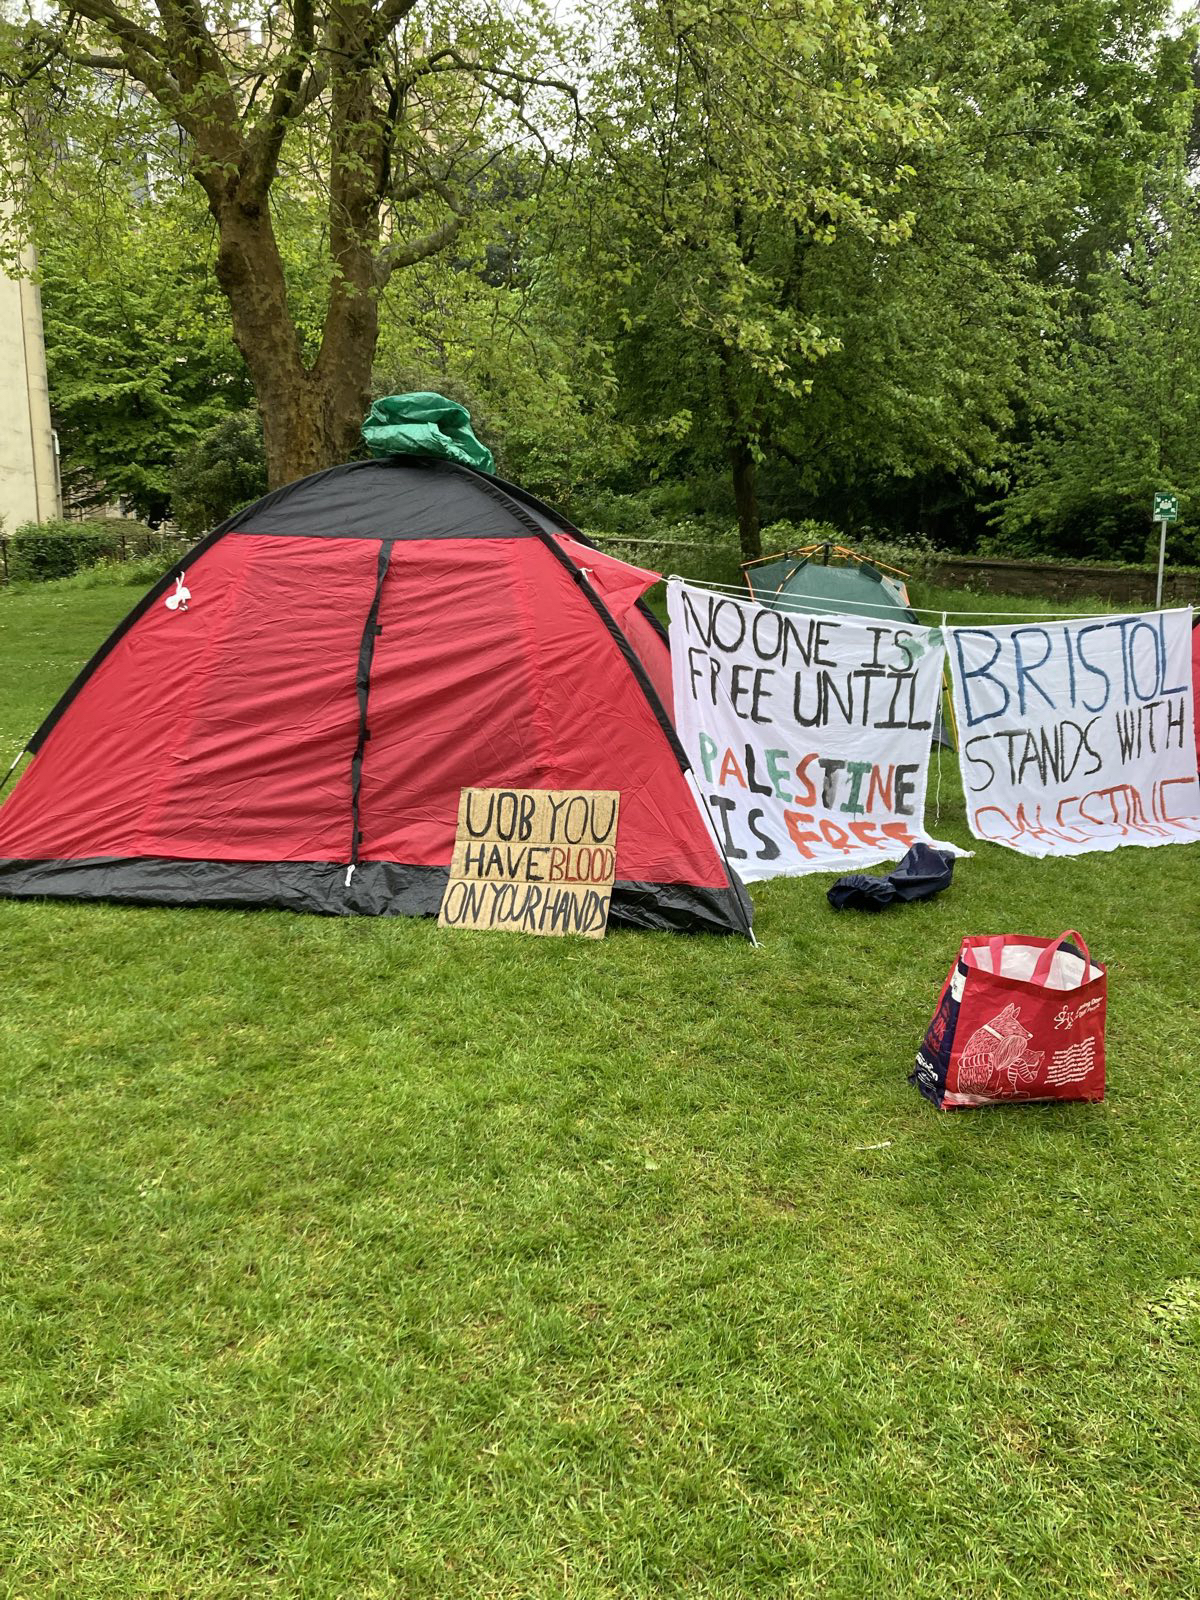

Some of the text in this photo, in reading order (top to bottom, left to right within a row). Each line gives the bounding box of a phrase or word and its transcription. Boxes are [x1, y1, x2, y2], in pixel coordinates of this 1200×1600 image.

[681, 590, 914, 673] NO ONE IS
[953, 613, 1188, 728] BRISTOL
[688, 646, 932, 732] FREE UNTIL
[699, 731, 920, 816] PALESTINE
[965, 697, 1185, 792] STANDS WITH
[466, 791, 616, 845] UOB YOU
[709, 794, 782, 861] IS
[464, 842, 615, 883] HAVE BLOOD
[444, 880, 611, 933] ON YOUR HANDS
